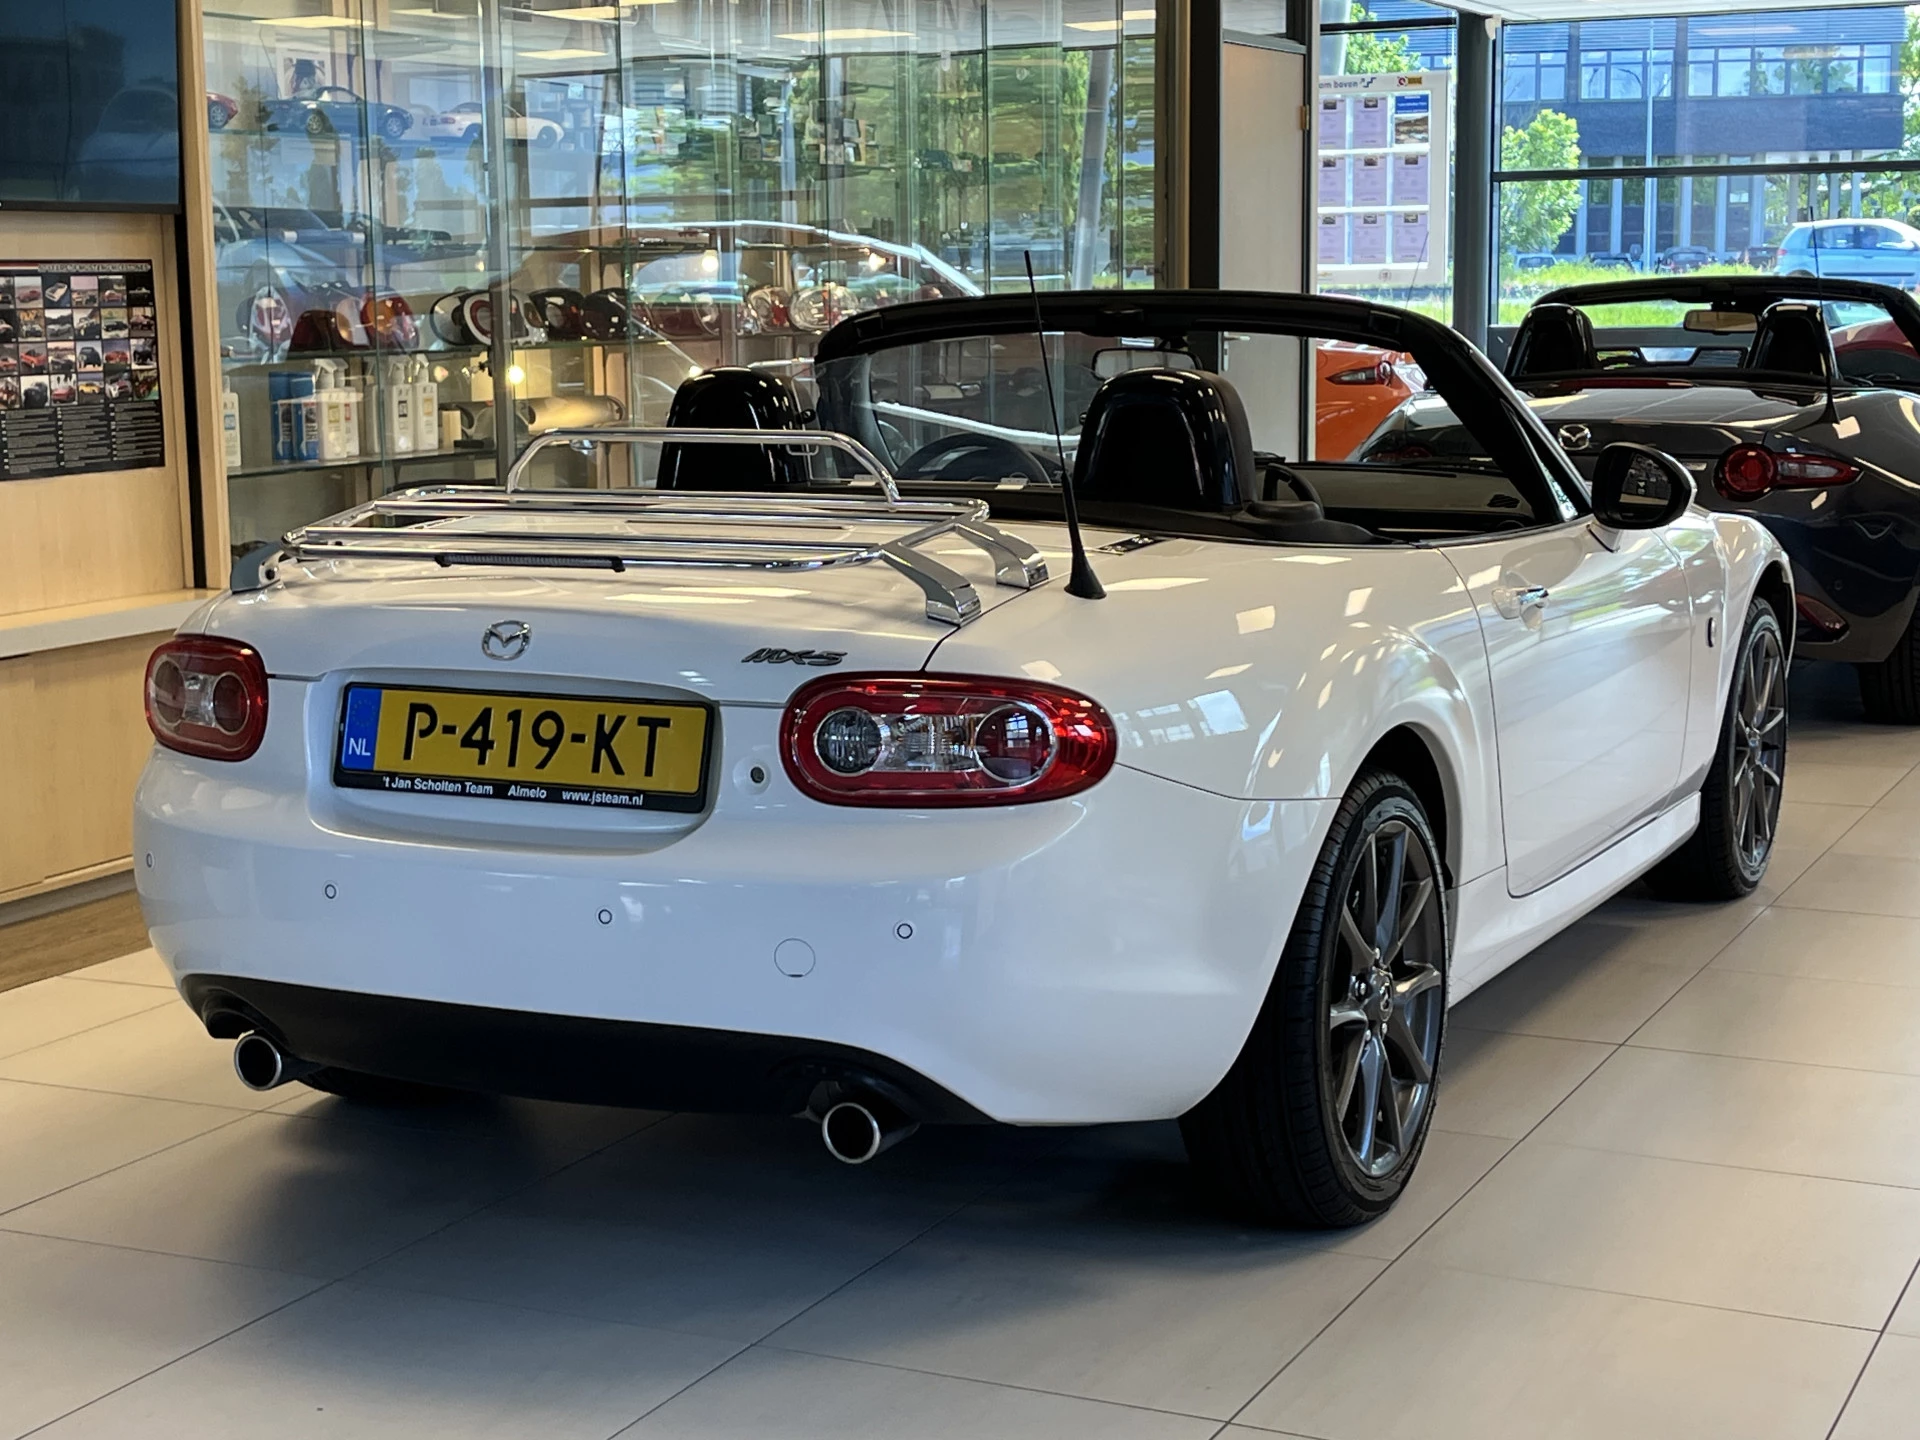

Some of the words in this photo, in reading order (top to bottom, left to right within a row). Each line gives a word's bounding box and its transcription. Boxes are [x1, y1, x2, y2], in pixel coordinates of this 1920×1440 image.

[348, 737, 371, 756] NL
[403, 702, 671, 777] P-419-KT
[391, 777, 411, 789] Jan
[413, 778, 462, 793] Scholten
[464, 781, 493, 795] Team
[507, 784, 547, 799] Almelo
[561, 789, 643, 806] www.jsteam.nl
